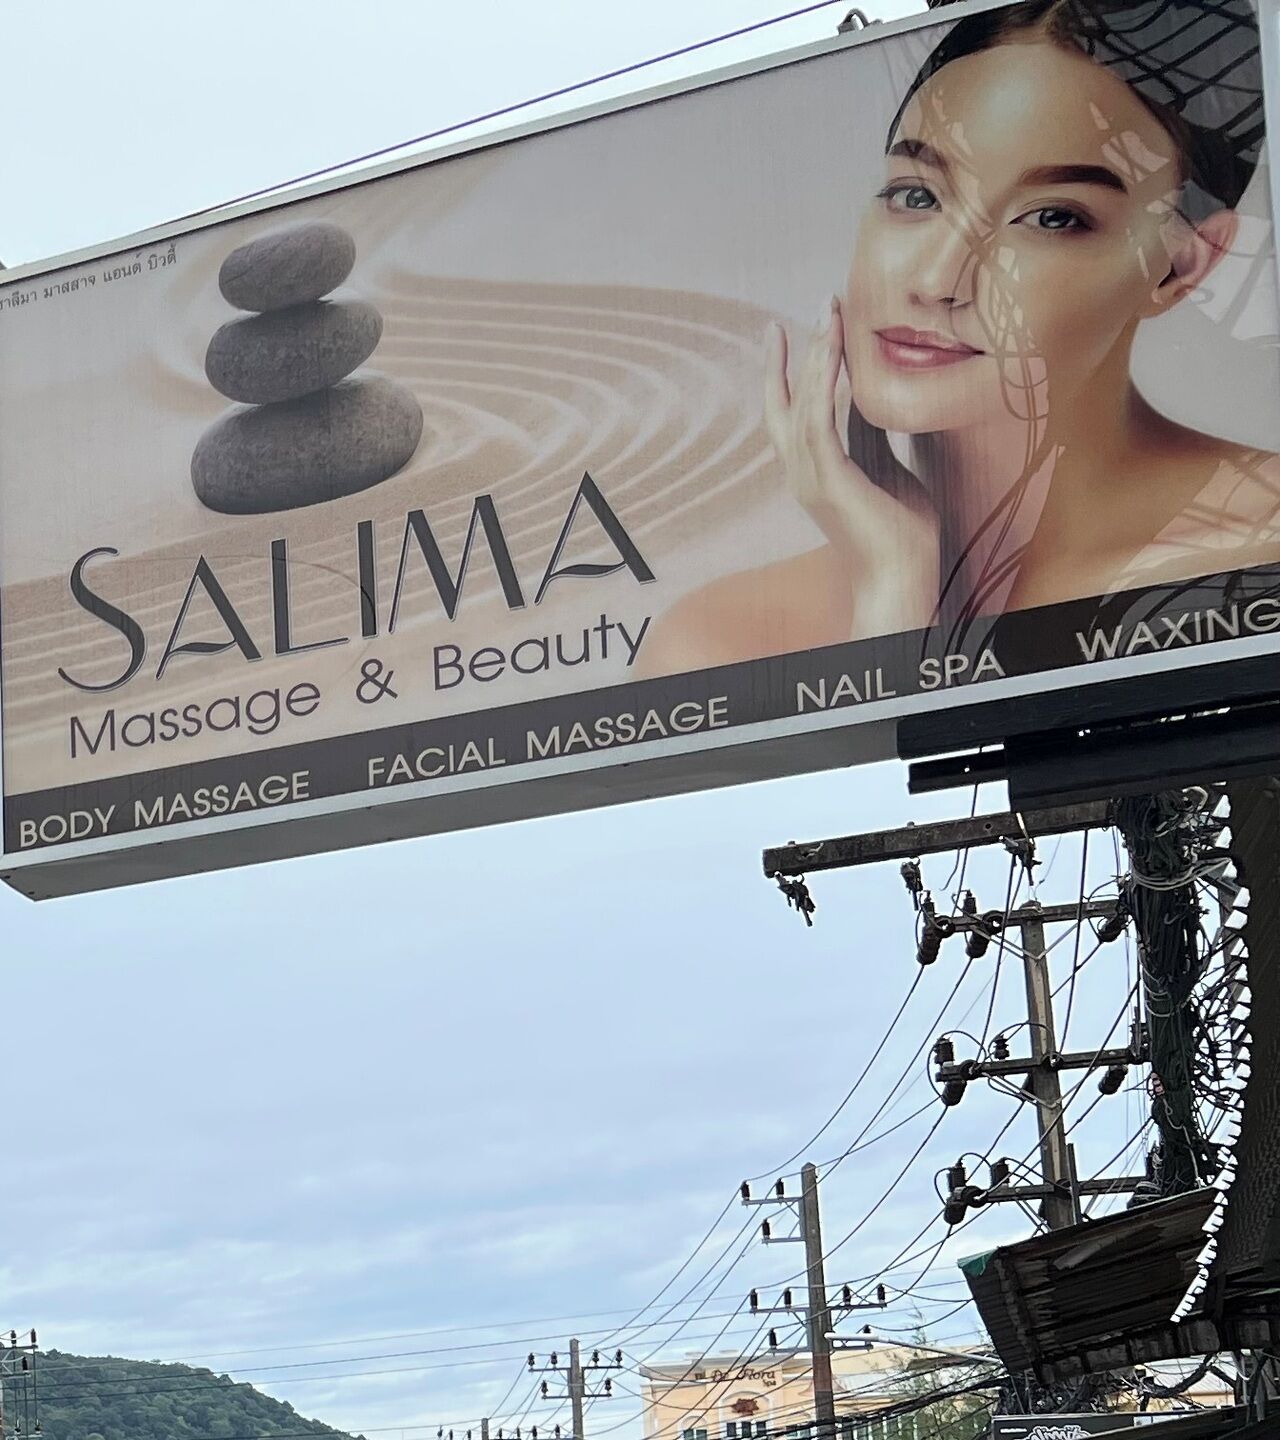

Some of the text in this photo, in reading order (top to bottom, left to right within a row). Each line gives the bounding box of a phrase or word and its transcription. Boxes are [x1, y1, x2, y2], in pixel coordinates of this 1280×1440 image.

[57, 470, 657, 694] SALIMA
[68, 613, 653, 759] Massage & Beauty
[18, 598, 1280, 848] BODY MASSAGE FACIAL MASSAGE NAIL SPA WAXING
